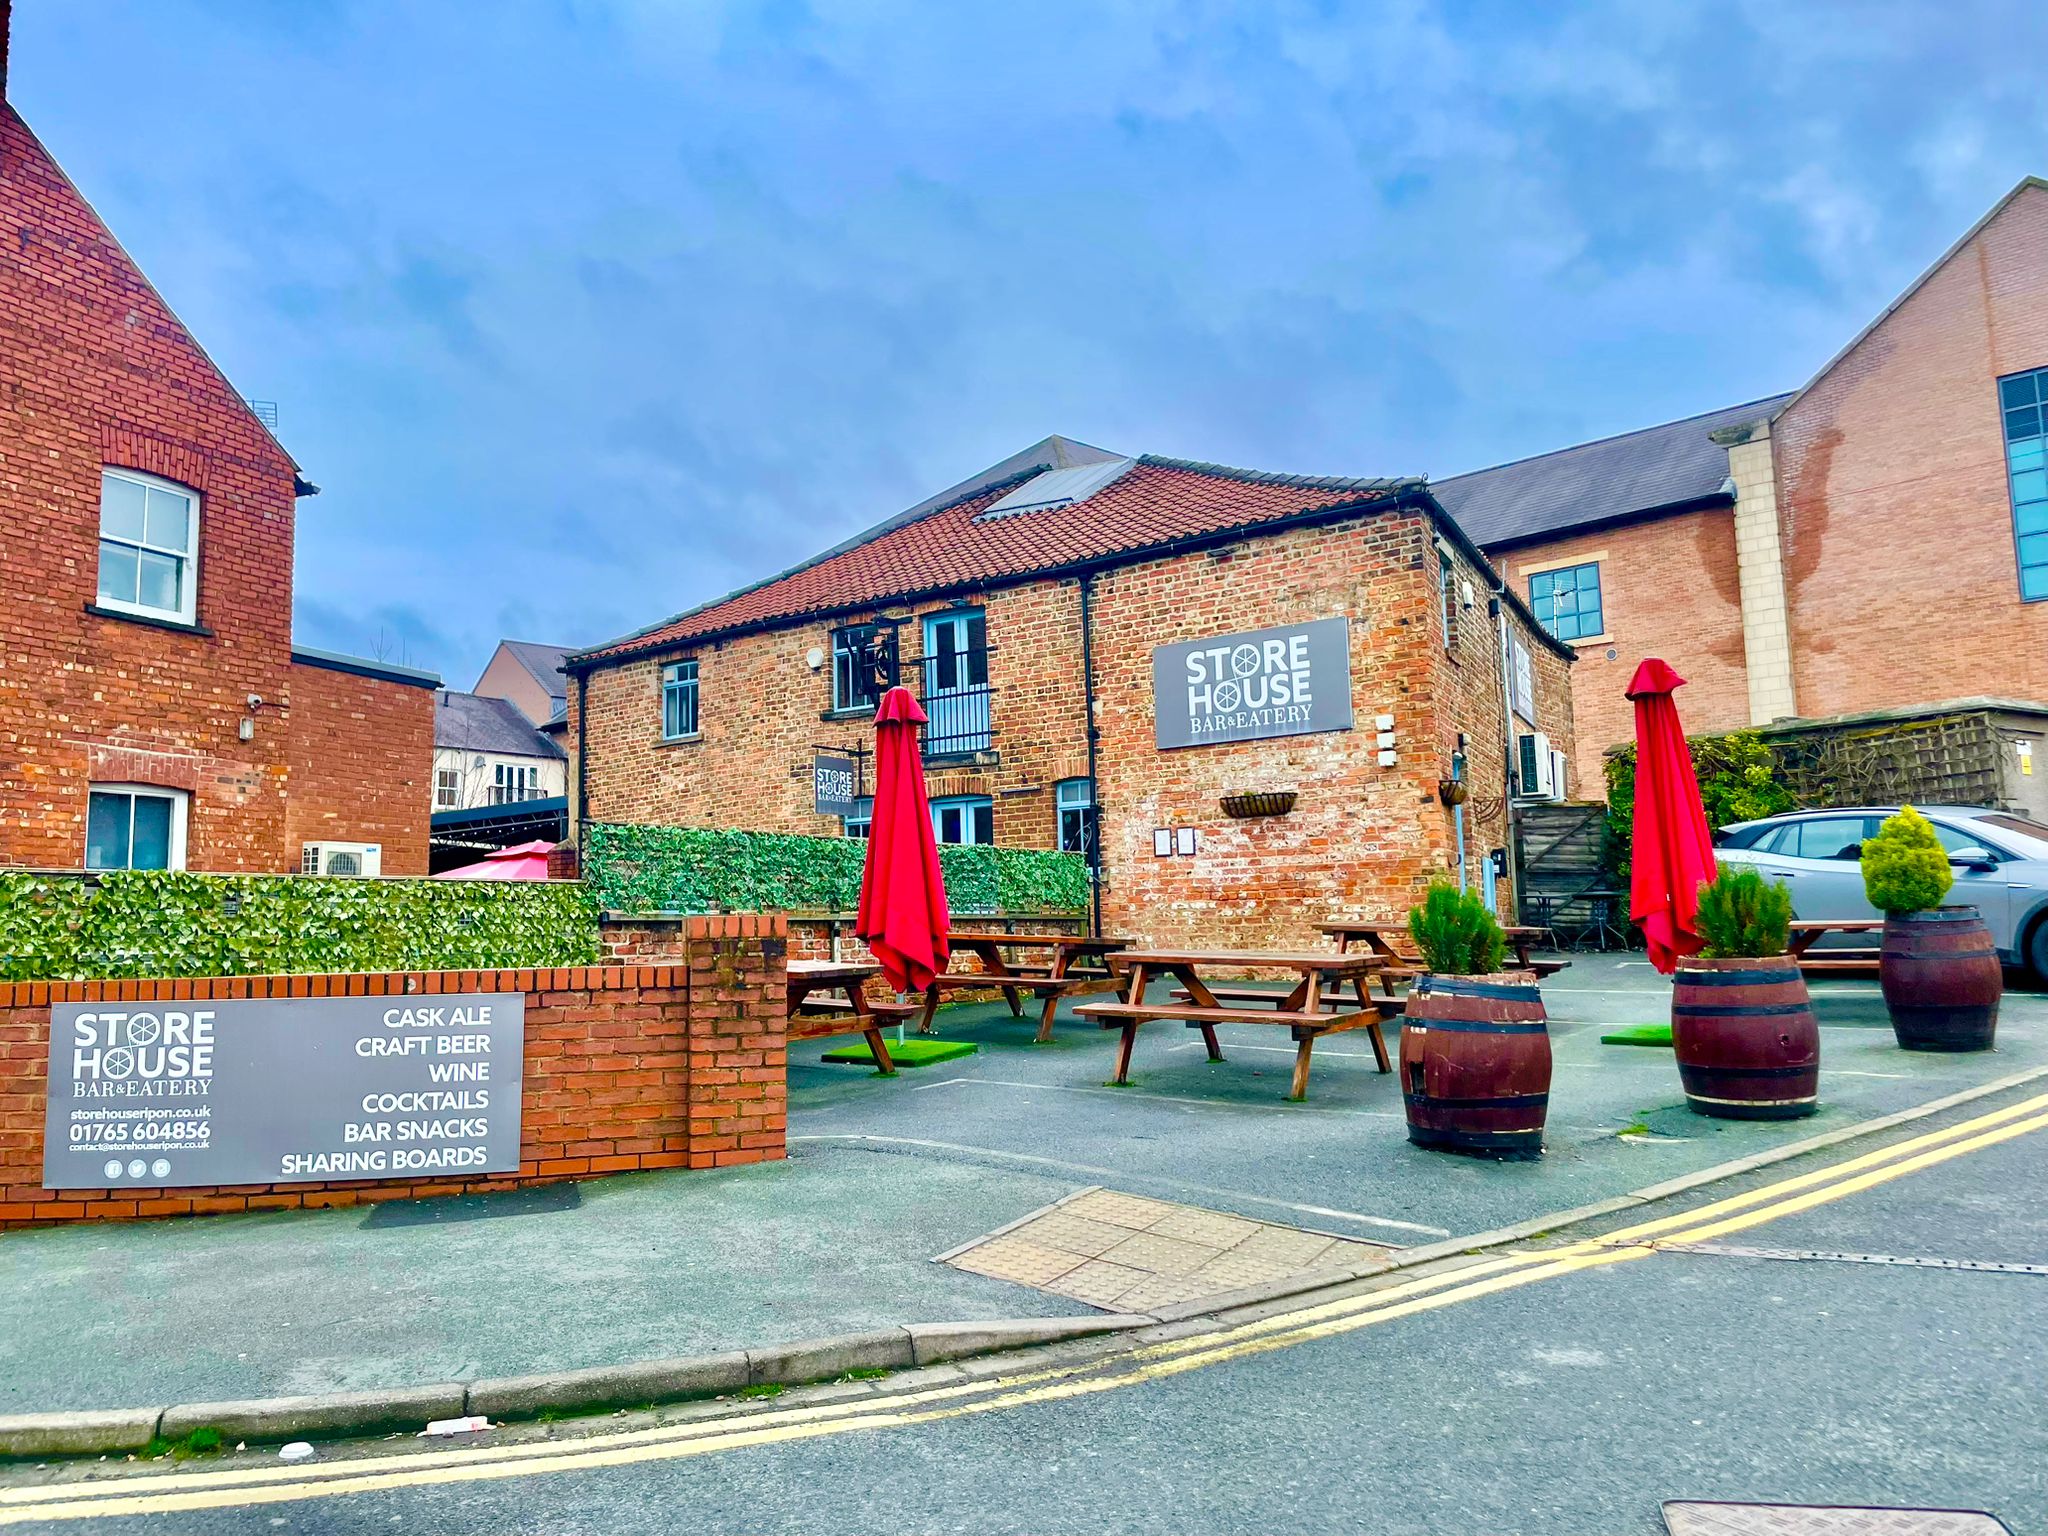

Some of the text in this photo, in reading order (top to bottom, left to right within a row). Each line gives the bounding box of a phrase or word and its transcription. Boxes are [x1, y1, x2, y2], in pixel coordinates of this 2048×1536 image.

[1186, 634, 1311, 685] STORE
[1187, 670, 1312, 717] HOUSE
[1190, 704, 1312, 734] BAR&EATERY
[817, 768, 852, 785] STORE
[817, 782, 852, 797] HOUSE
[383, 1006, 492, 1028] CASK ALE
[74, 1011, 216, 1047] STORE
[355, 1034, 492, 1057] CRAFT BEER
[72, 1046, 214, 1080] HOUSE
[428, 1062, 490, 1083] WINE
[73, 1078, 213, 1098] BAR&EATERY
[70, 1105, 211, 1121] storehouseripon.co.uk
[361, 1090, 489, 1113] COCKTAILS
[69, 1121, 211, 1142] 01765 604856
[344, 1118, 488, 1143] BAR SNACKS
[69, 1139, 210, 1152] contact@storehouseripon.co.uk
[281, 1146, 487, 1174] SHARING BOARDS
